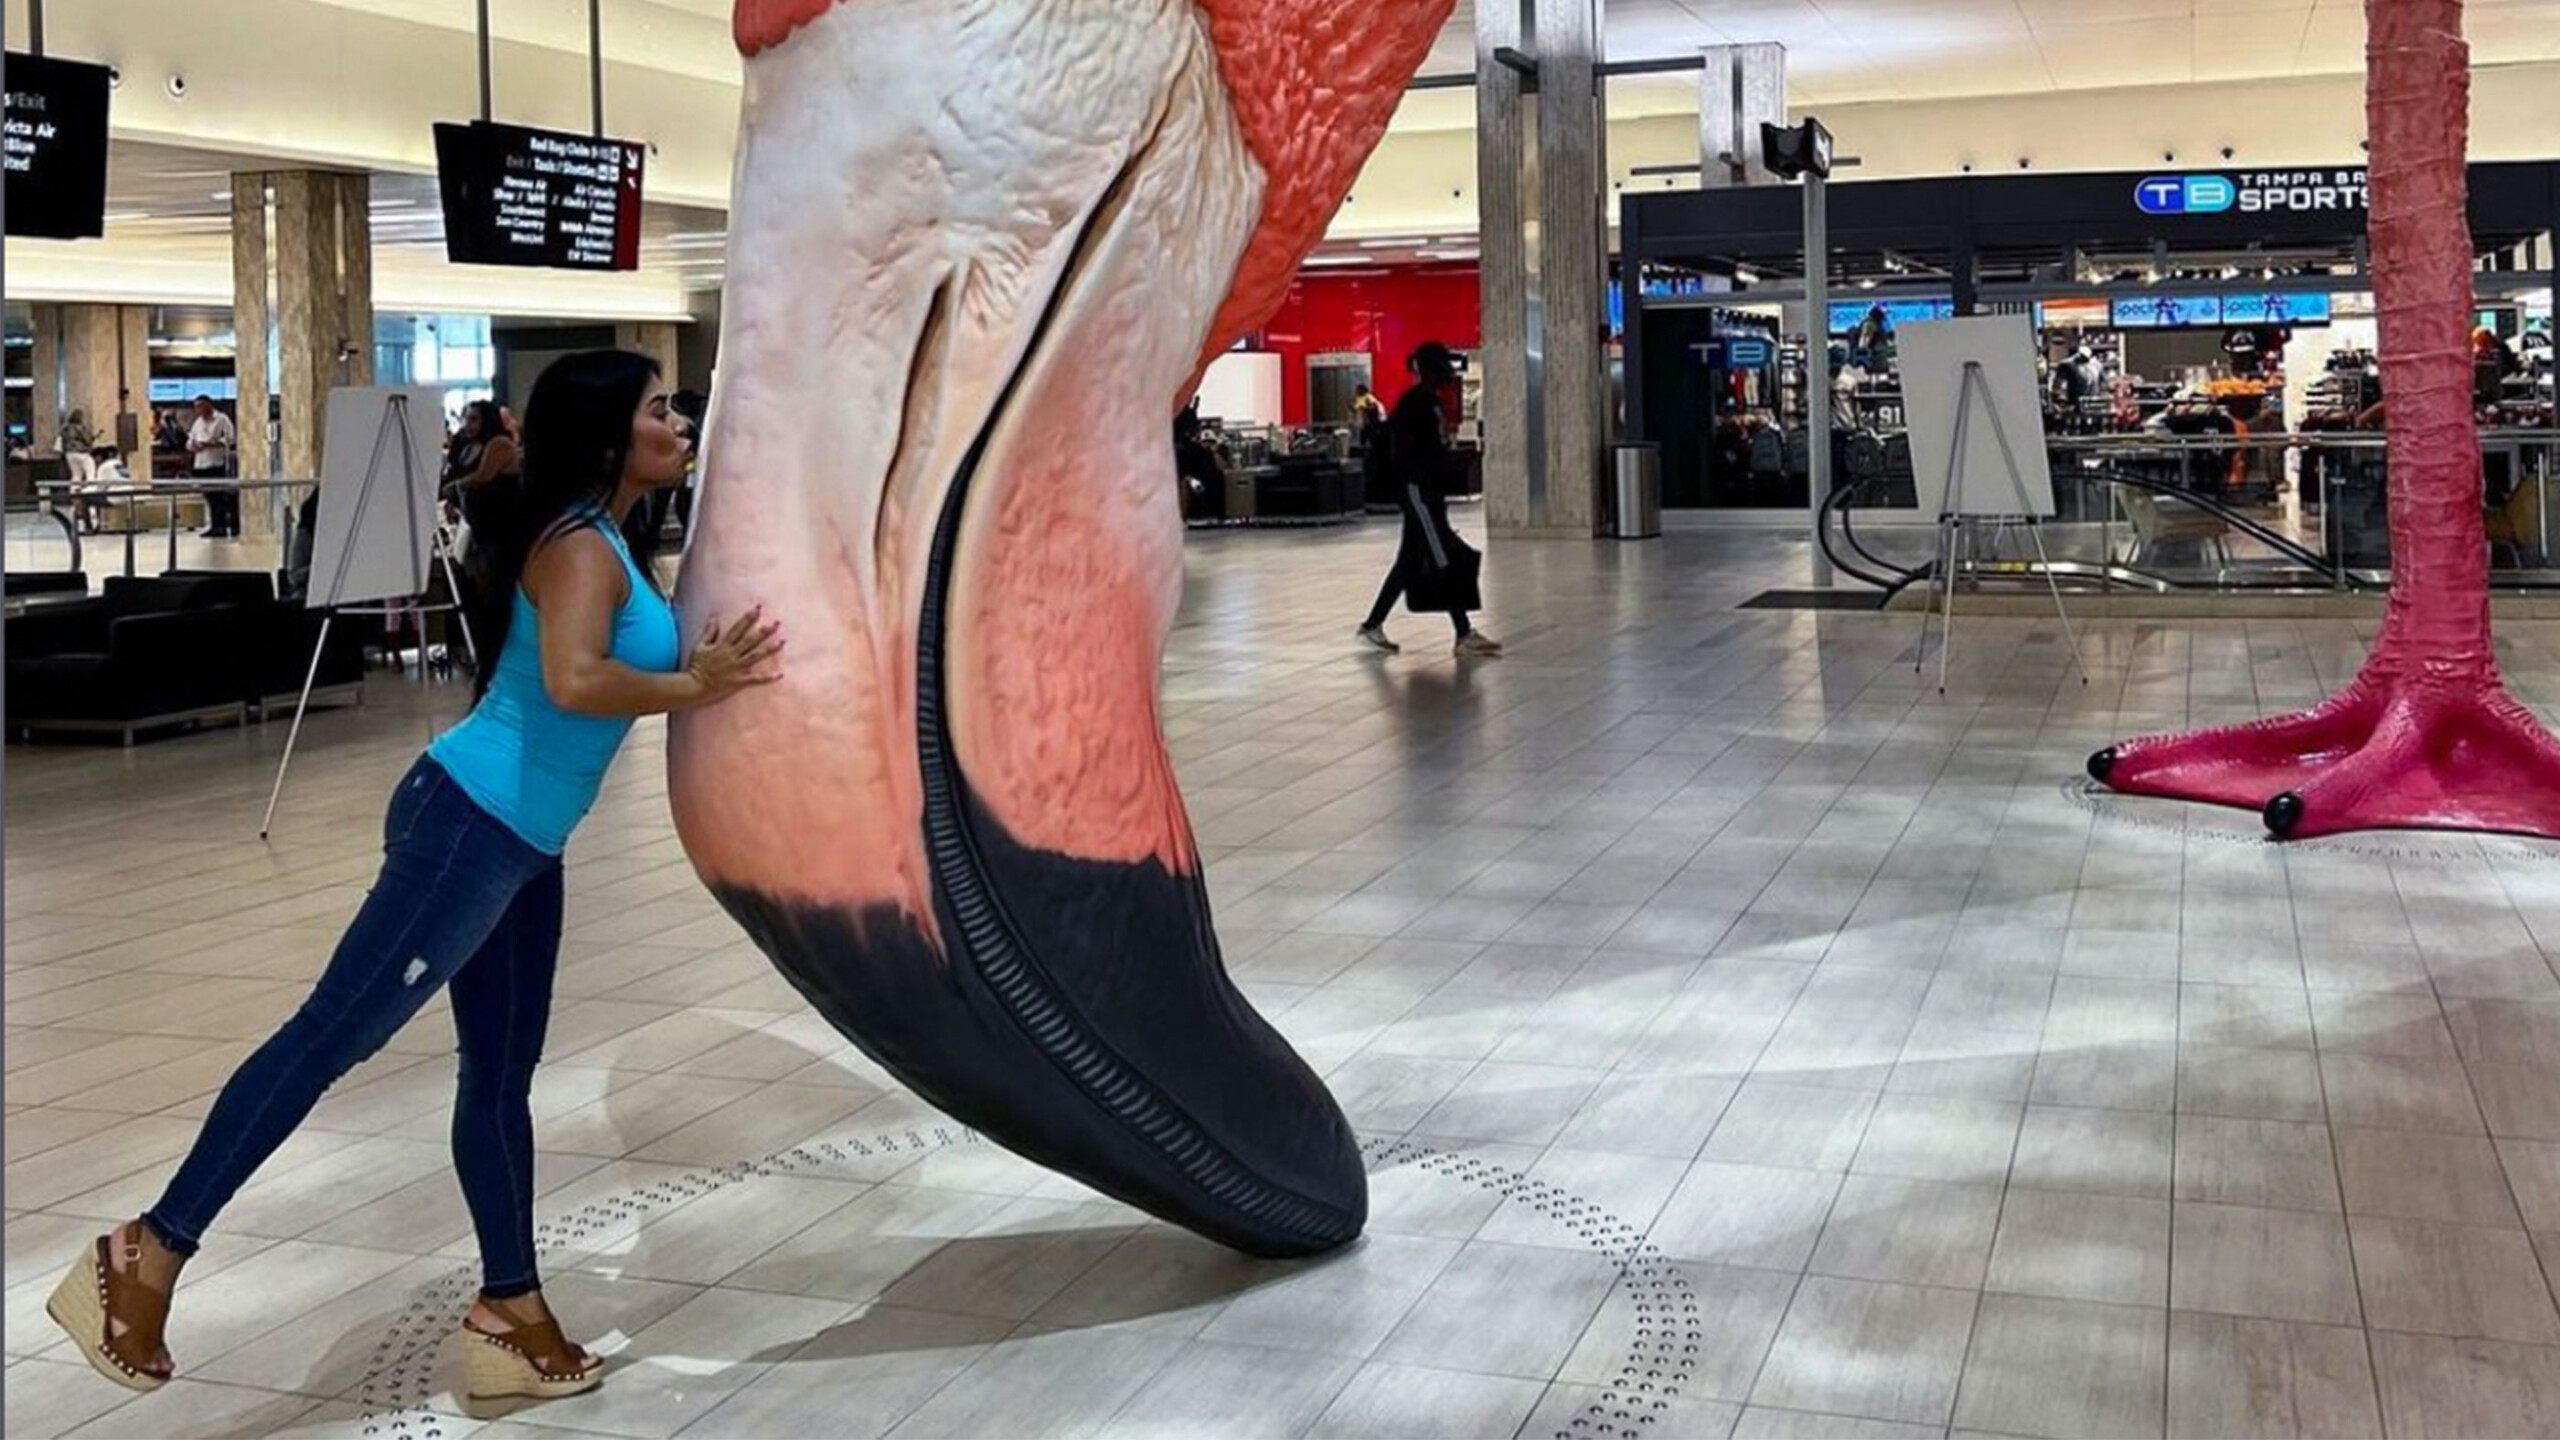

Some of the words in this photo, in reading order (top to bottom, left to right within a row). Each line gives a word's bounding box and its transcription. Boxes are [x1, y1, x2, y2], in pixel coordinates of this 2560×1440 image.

[567, 142, 590, 157] Claim
[506, 154, 524, 168] Exit
[2239, 172, 2323, 187] TAMPA
[2335, 171, 2368, 184] BA
[2145, 182, 2226, 207] TB
[501, 204, 546, 218] Southwest
[1689, 342, 1764, 363] TB
